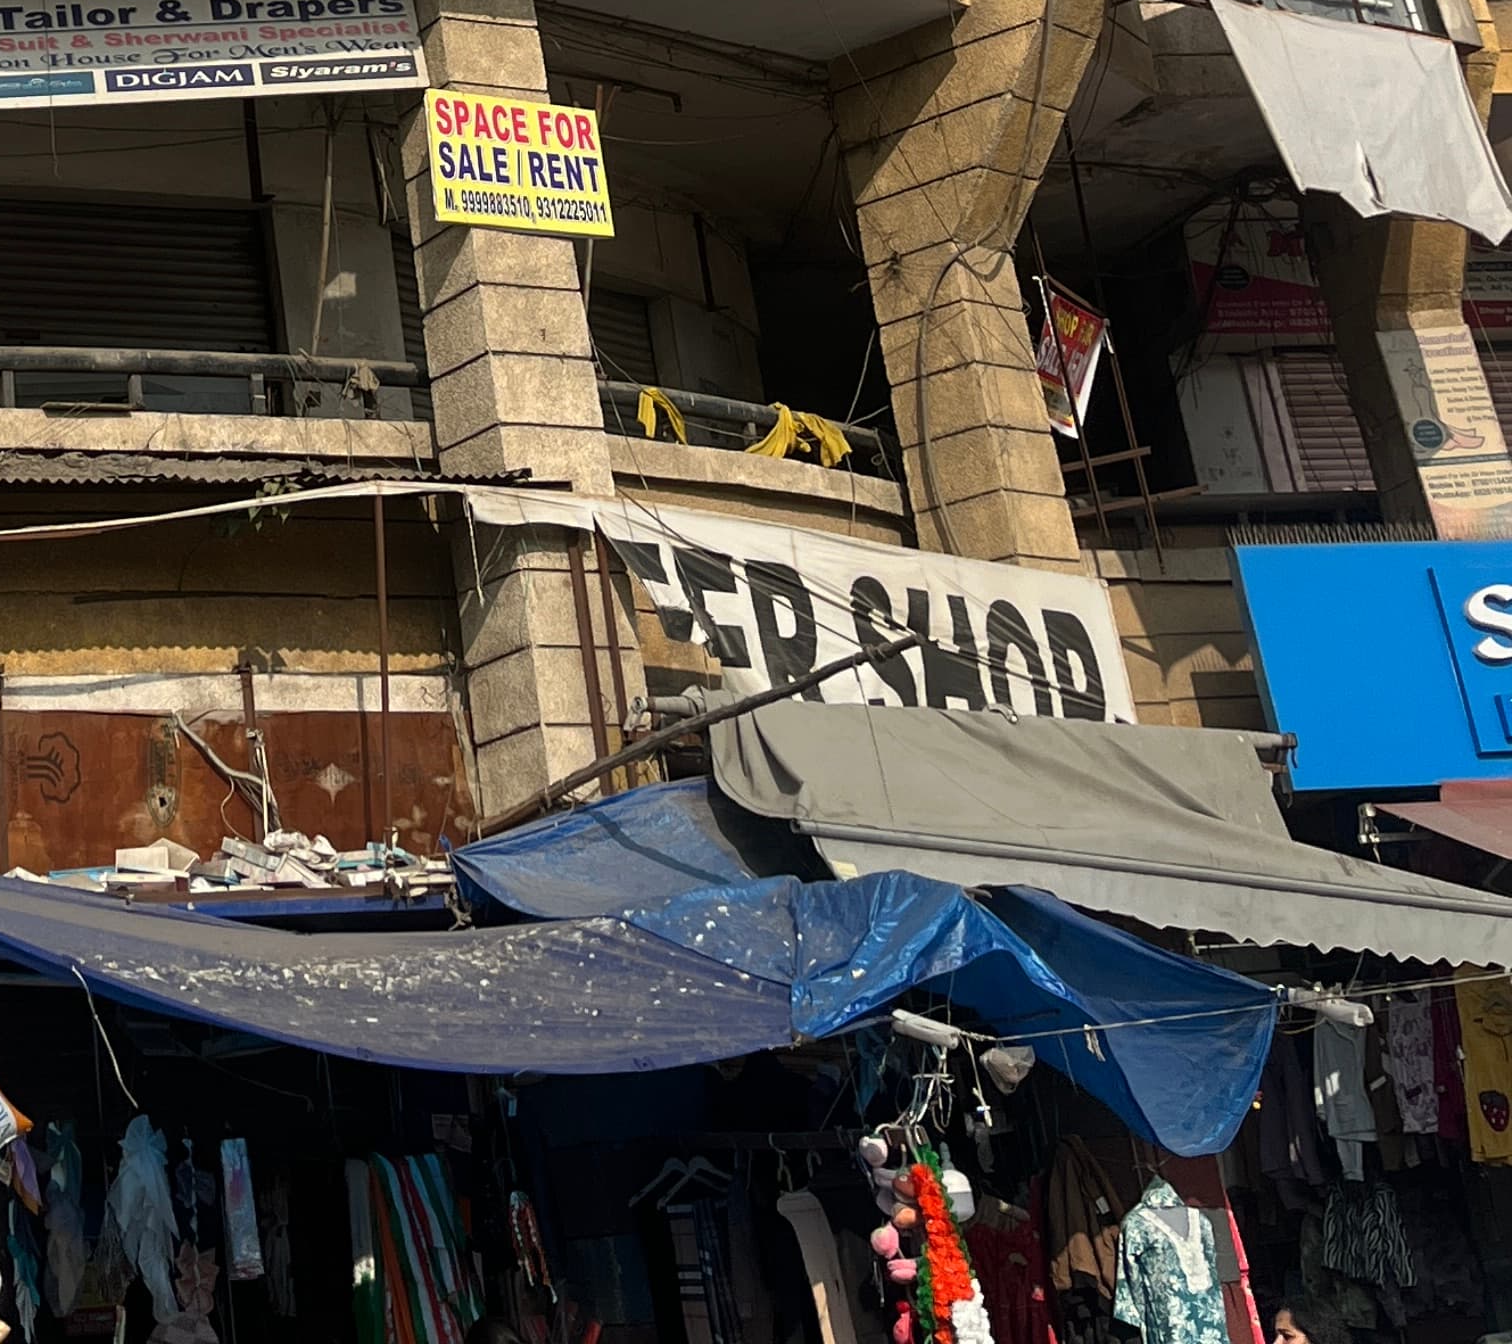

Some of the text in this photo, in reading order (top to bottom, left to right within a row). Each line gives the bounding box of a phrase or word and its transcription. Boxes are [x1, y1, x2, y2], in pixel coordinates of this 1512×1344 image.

[156, 0, 192, 23] &
[69, 34, 93, 49] &
[104, 26, 248, 47] Sherwani
[259, 19, 413, 41] Specialist
[40, 50, 141, 67] House
[153, 47, 220, 65] For
[229, 41, 318, 60] Men's
[325, 39, 416, 52] Wear
[116, 67, 244, 88] DIGJAM
[270, 61, 413, 79] Siyaram's
[435, 97, 596, 151] SPACE FOR
[438, 140, 599, 193] SALE RENT
[444, 187, 608, 223] M. 9999883510, 9312225011
